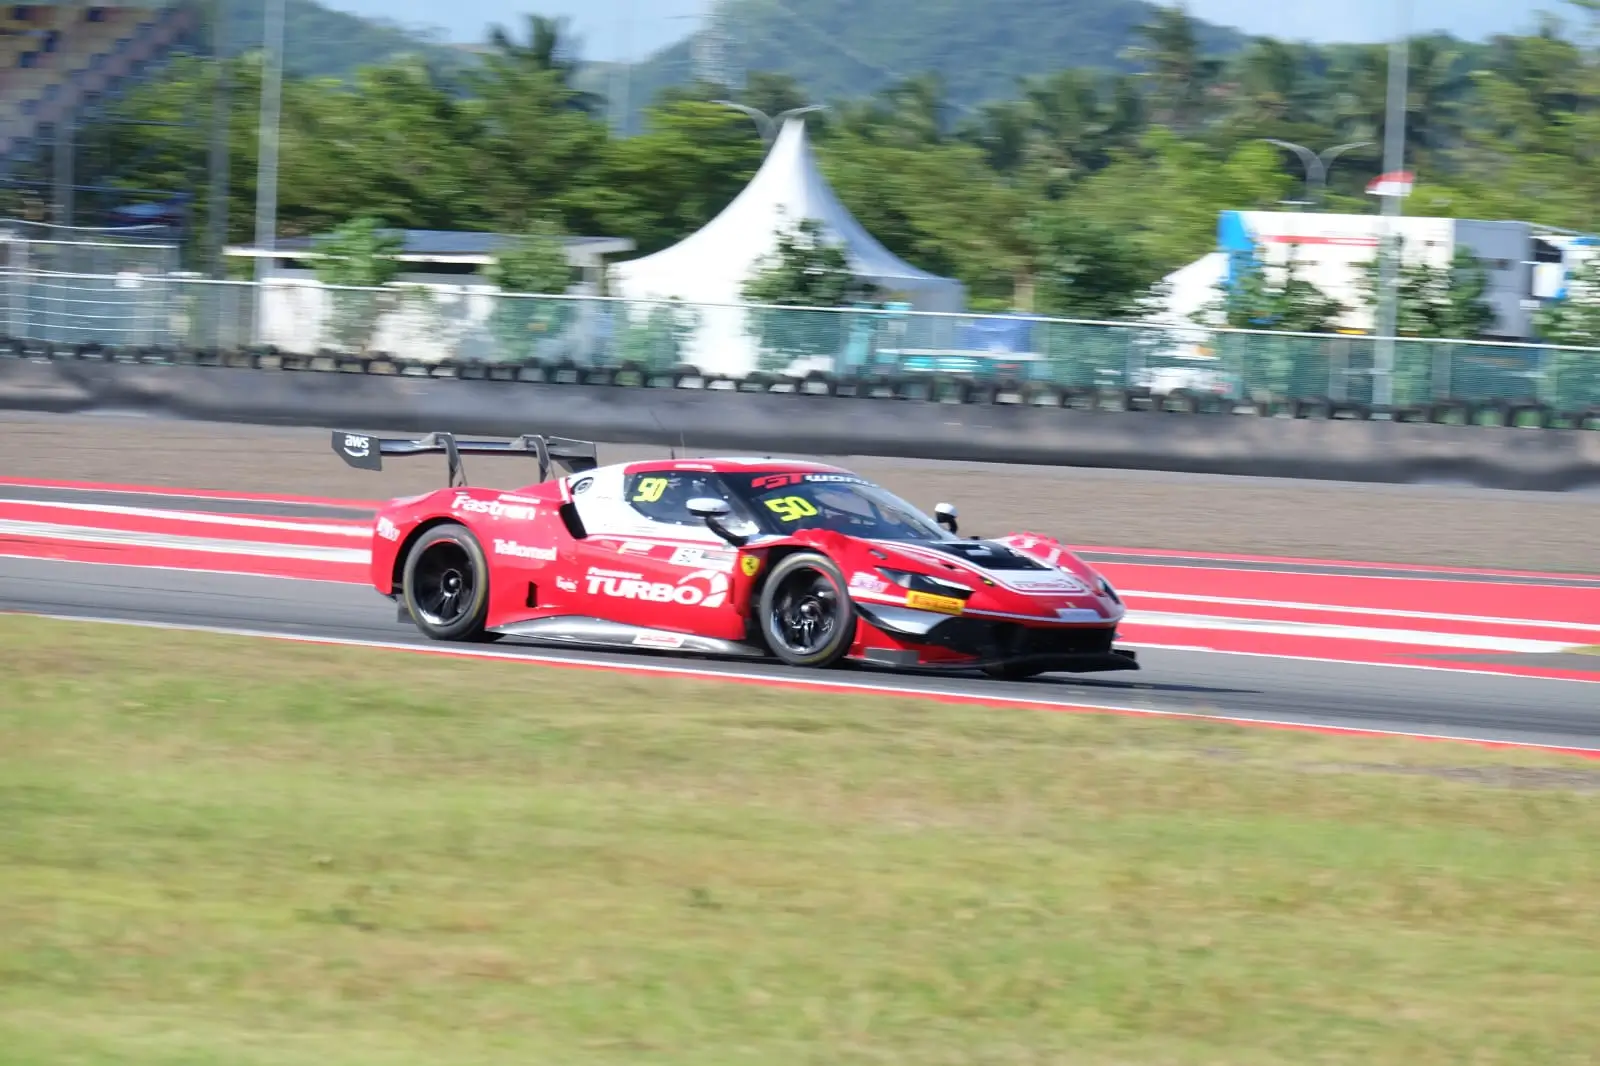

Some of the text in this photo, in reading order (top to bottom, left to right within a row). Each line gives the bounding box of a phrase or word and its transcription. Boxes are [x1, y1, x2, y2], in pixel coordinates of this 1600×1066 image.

[345, 434, 369, 449] aws
[632, 477, 668, 502] 50
[764, 495, 818, 522] 50
[586, 575, 702, 605] TURBO
